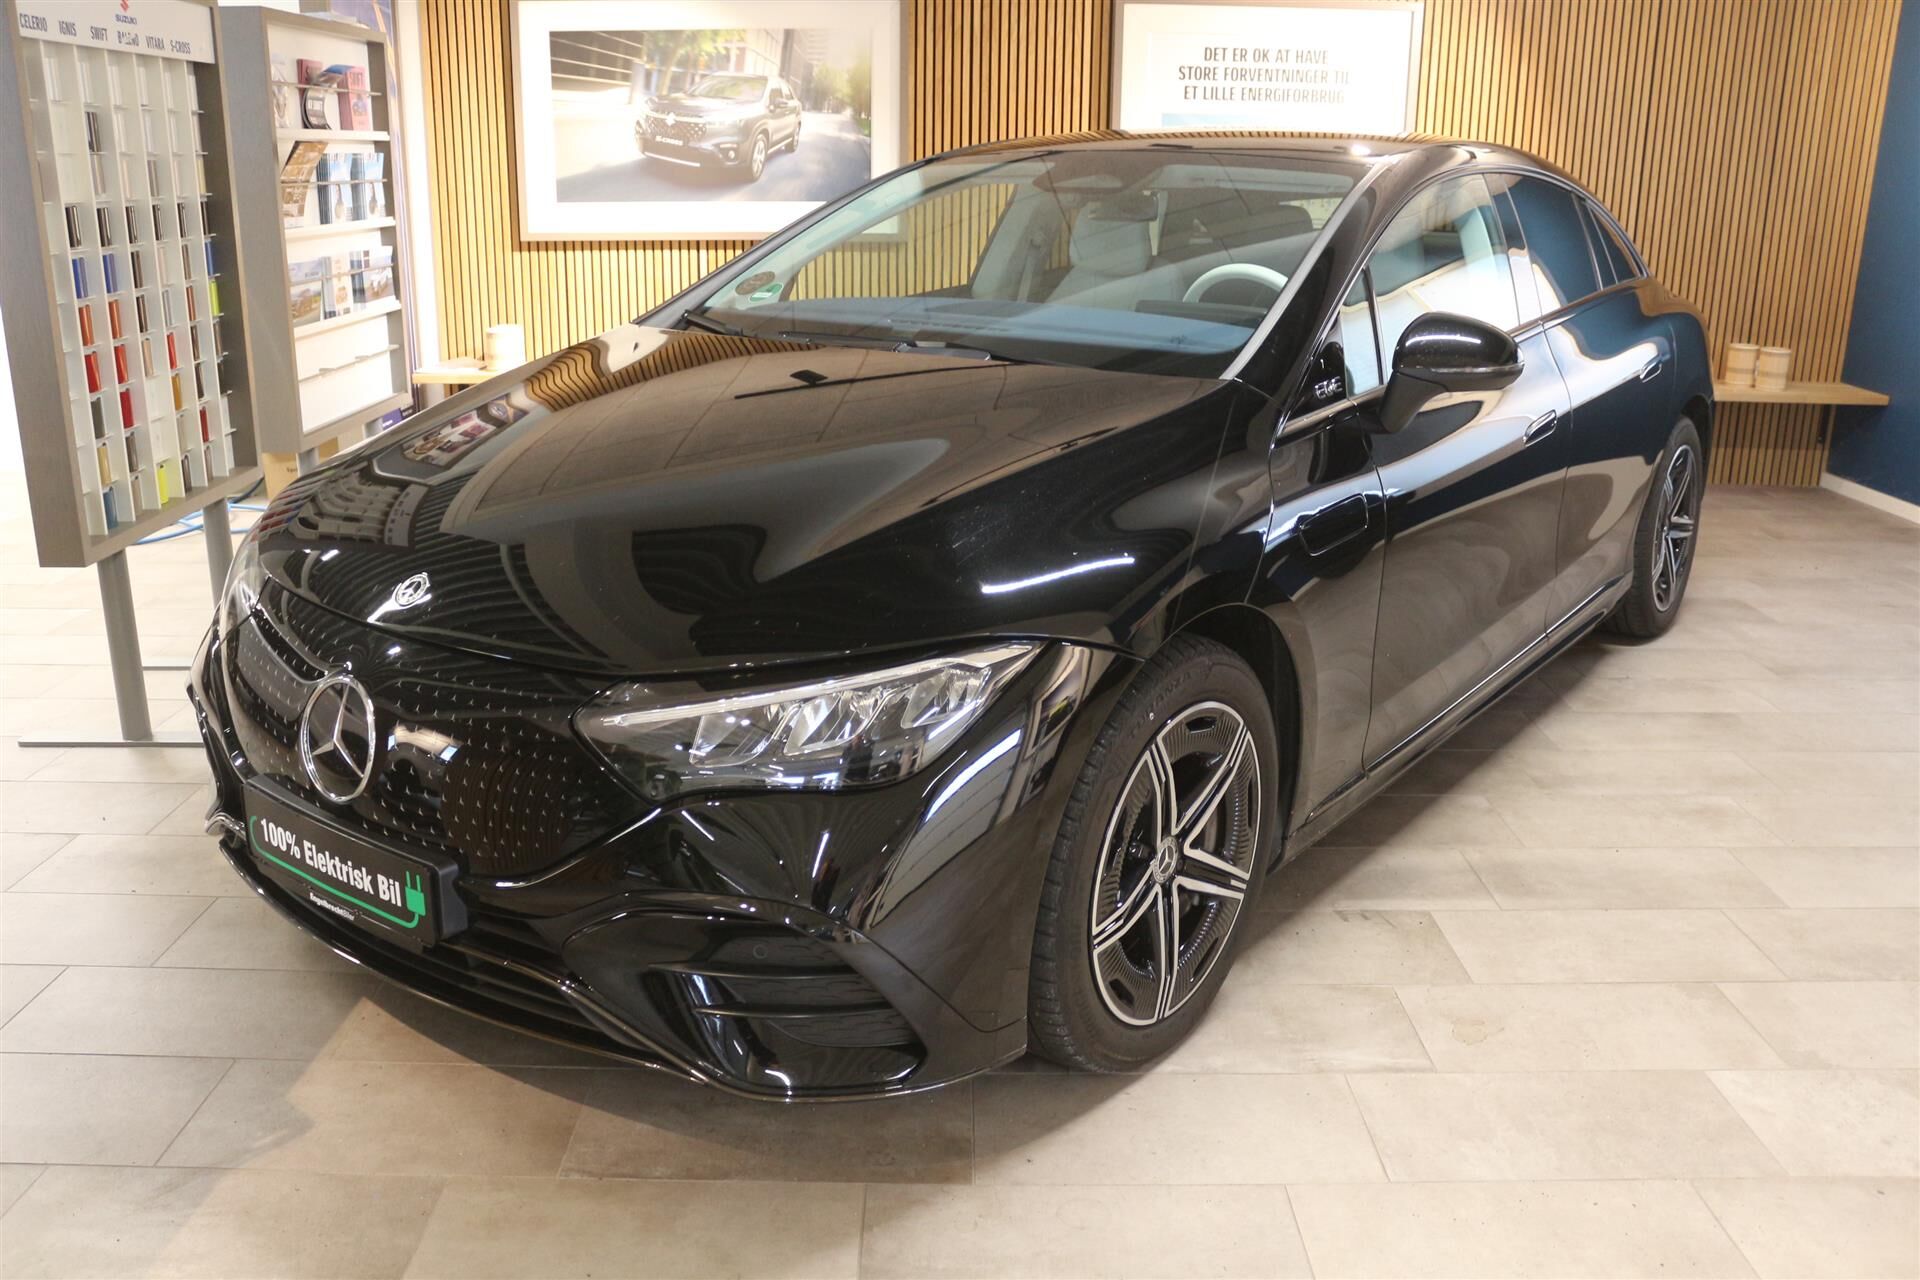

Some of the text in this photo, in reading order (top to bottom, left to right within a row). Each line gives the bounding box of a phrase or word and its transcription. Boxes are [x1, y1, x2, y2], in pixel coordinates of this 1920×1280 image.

[115, 14, 138, 25] SUZUKI
[19, 13, 47, 32] CELERIO
[59, 20, 77, 37] IGNIS
[90, 26, 108, 42] SWIFT
[146, 35, 165, 50] VITARA
[170, 40, 191, 55] S-CROSS
[1204, 47, 1328, 65] DET ER OK AT HAVE
[1178, 65, 1218, 81] STORE
[1224, 67, 1328, 84] FORVENTNINGER
[1184, 85, 1344, 104] ET LILLE ENERGIFORBRUG
[261, 818, 402, 907] 100% Elektrisk Bil
